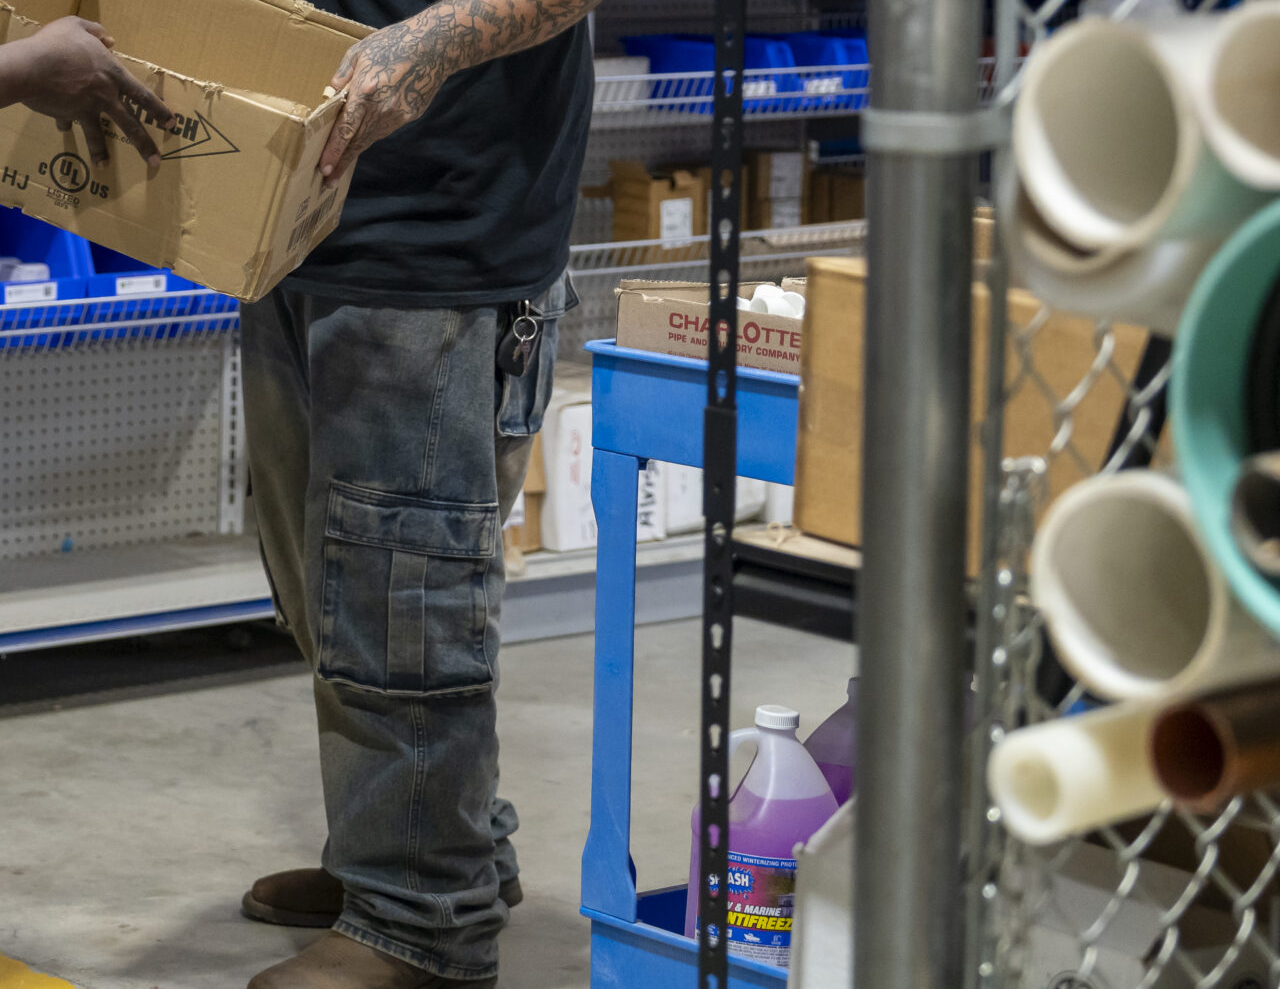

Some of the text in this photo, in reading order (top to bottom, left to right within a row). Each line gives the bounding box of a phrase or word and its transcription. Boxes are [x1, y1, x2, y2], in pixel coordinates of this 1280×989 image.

[2, 165, 30, 191] HJ
[60, 159, 80, 187] UL
[90, 181, 110, 199] US
[47, 187, 80, 205] LISTED
[668, 332, 687, 343] PIPE
[690, 336, 708, 346] AND
[756, 347, 802, 363] COMPANY
[742, 857, 780, 867] WINTERIZING
[734, 903, 742, 912] &
[744, 905, 782, 917] MARINE
[728, 911, 793, 931] NTIFREEZ
